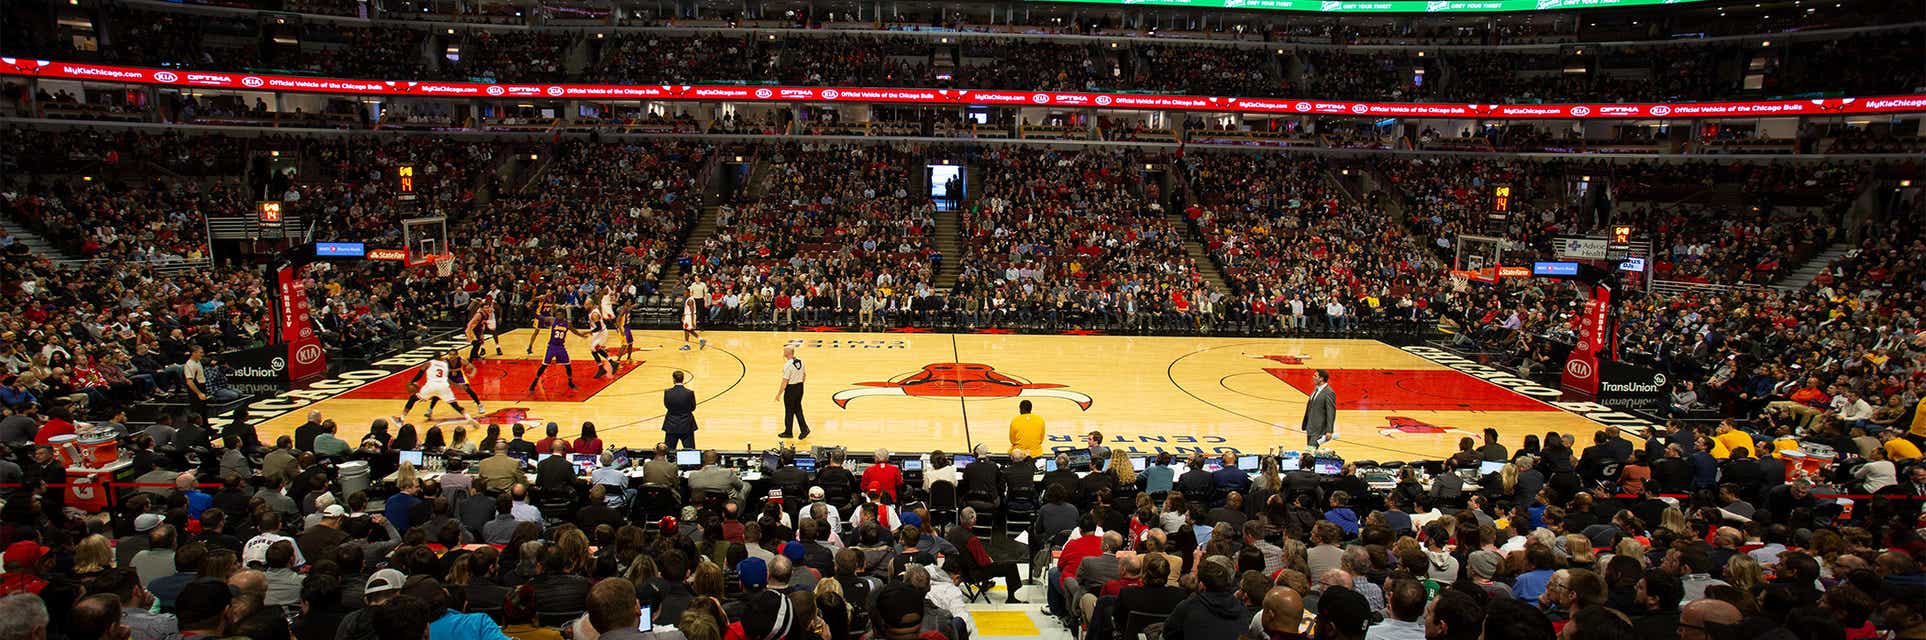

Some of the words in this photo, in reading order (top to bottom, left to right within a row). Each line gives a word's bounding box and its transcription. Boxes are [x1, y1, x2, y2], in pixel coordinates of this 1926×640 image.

[64, 66, 142, 78] MyKiaChicago.com
[156, 73, 176, 81] KIA
[187, 74, 231, 82] OPTIMA
[244, 78, 262, 86] KIA
[488, 87, 503, 95] KIA
[1572, 107, 1588, 115] KIA
[1652, 107, 1669, 115] KIA
[402, 178, 412, 192] 14
[1497, 198, 1507, 211] 14
[299, 346, 318, 362] KIA
[435, 368, 444, 378] 3
[1570, 361, 1588, 376] KIA
[1601, 381, 1658, 392] TransUnion
